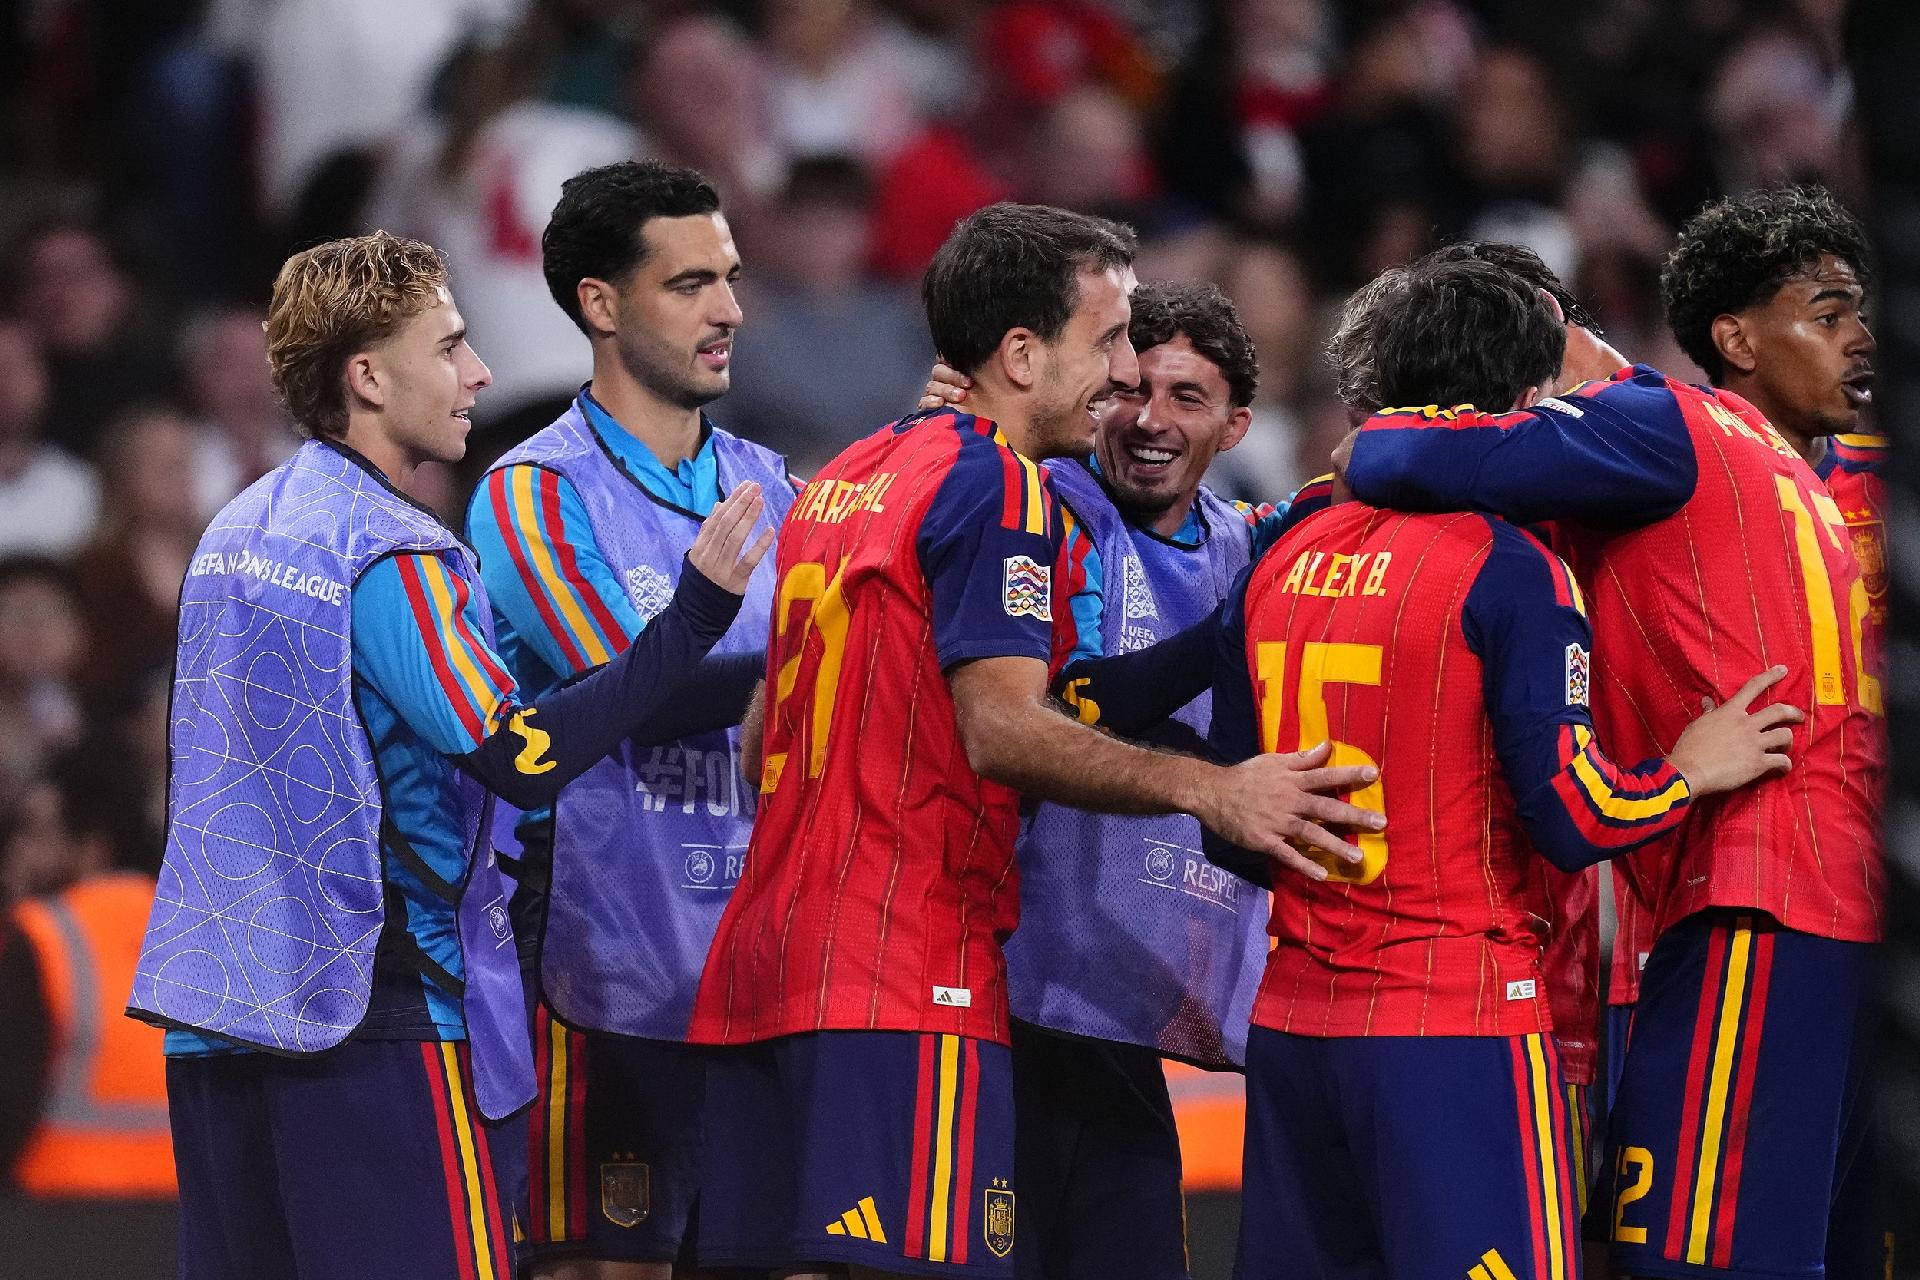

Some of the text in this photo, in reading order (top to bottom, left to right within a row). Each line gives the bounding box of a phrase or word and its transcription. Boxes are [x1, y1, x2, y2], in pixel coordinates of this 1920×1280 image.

[270, 562, 345, 607] LEAGUE
[1281, 550, 1392, 598] ALEX B.
[1128, 625, 1157, 642] UEFA
